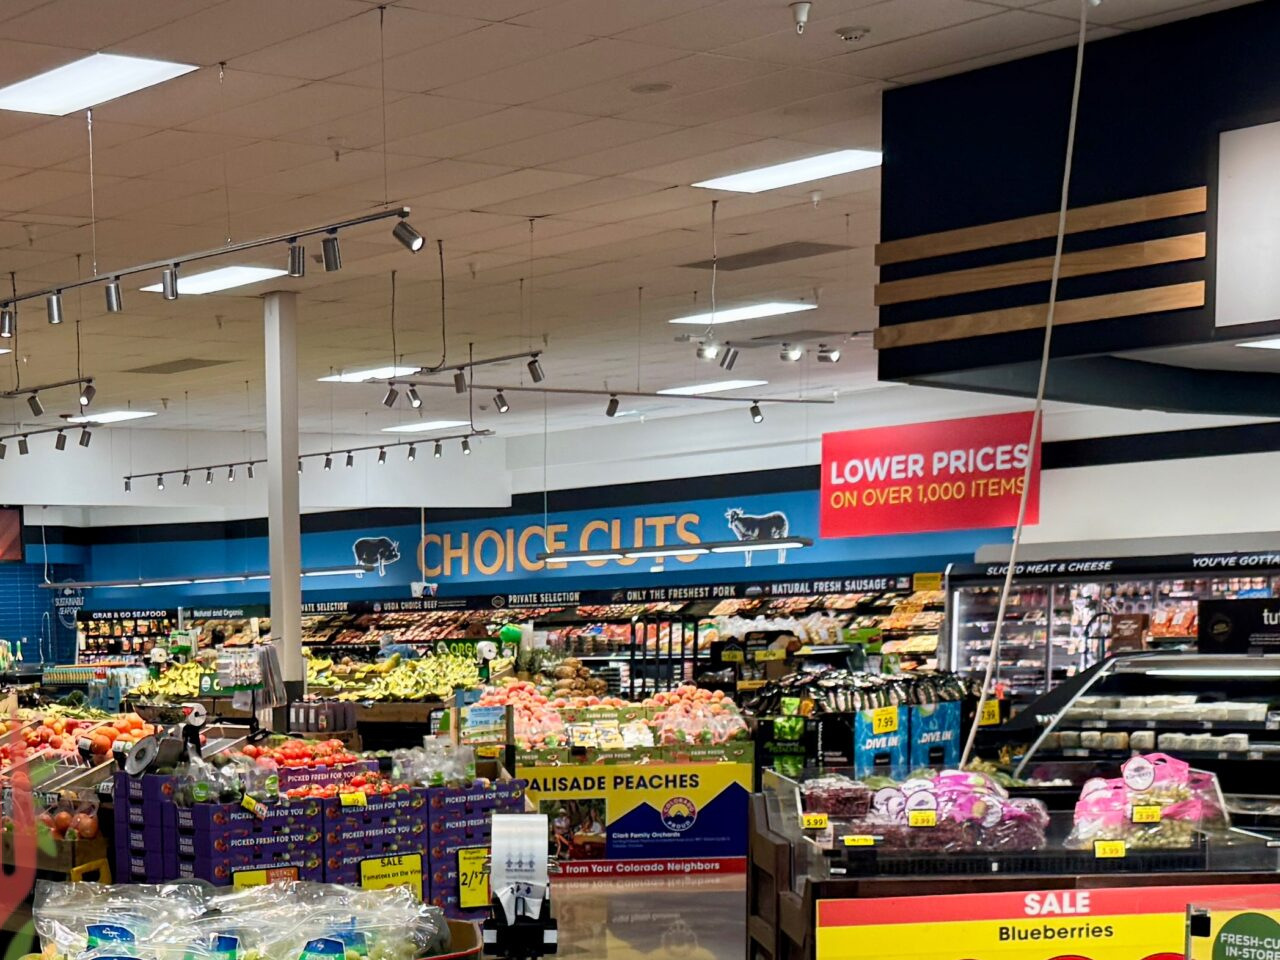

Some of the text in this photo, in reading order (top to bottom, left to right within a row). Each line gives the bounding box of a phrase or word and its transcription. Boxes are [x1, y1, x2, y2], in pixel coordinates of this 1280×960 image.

[830, 443, 1031, 485] LOWER PRICES
[830, 477, 1027, 509] ON OVER 1,000 ITEMS
[416, 513, 702, 578] CHOICE CUTS
[986, 566, 1024, 576] SLICD
[1026, 564, 1056, 574] MEAT
[1068, 561, 1114, 573] CHEESE
[1192, 556, 1238, 568] YOU'VE
[626, 585, 736, 601] ONLY THE FRESHEST PORK
[771, 578, 888, 595] NATURAL FRESH SAUSAGE
[508, 592, 581, 604] PRIVATE SELECTION
[132, 610, 167, 618] SEAFOOD
[316, 602, 348, 612] SELECTION
[877, 716, 894, 728] 7.99
[613, 773, 700, 790] PEACHES
[380, 856, 404, 868] SALE
[566, 860, 721, 875] from Your Colorado Neighbors
[1023, 891, 1091, 916] SALE
[998, 922, 1115, 942] Blueberries
[1220, 932, 1280, 949] FRESH-CU
